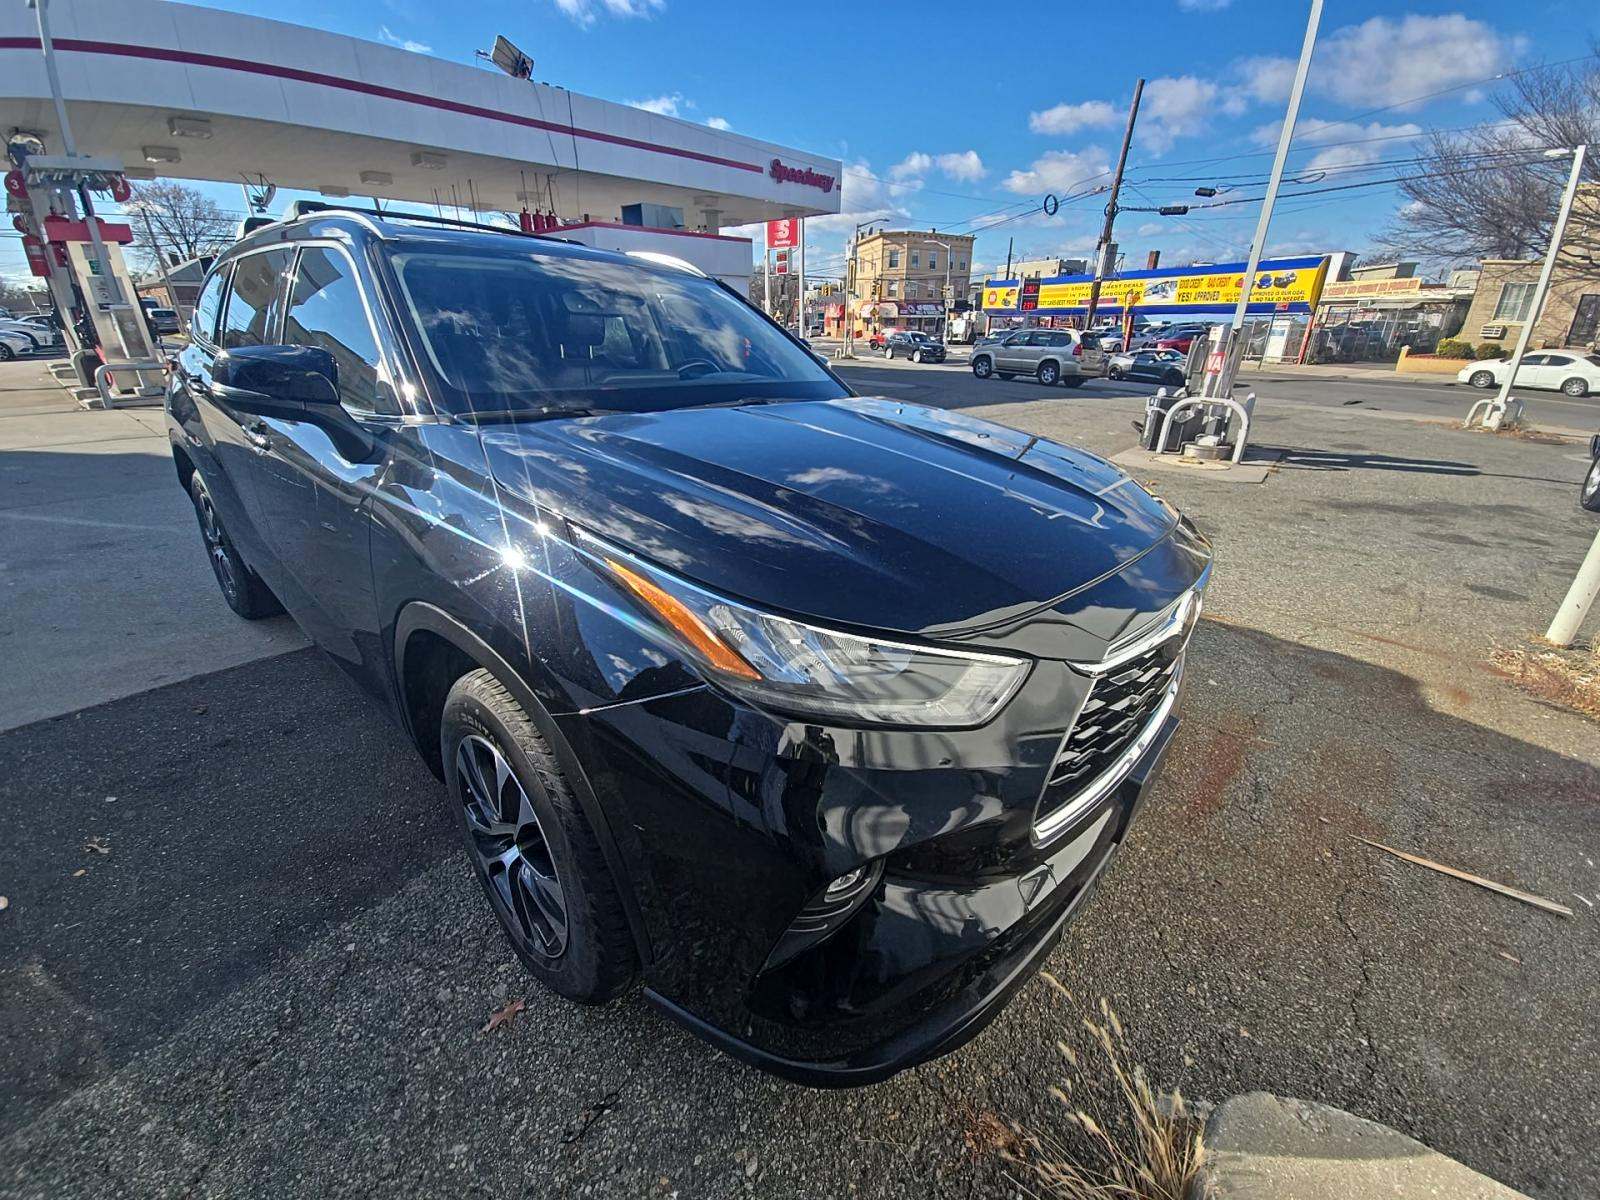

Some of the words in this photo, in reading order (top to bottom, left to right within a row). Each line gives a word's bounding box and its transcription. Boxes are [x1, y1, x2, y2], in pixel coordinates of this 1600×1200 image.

[769, 159, 835, 193] Speedway
[10, 179, 20, 190] 3
[116, 180, 125, 193] 4
[1177, 292, 1192, 302] YES!
[1193, 290, 1220, 301] APPROVED
